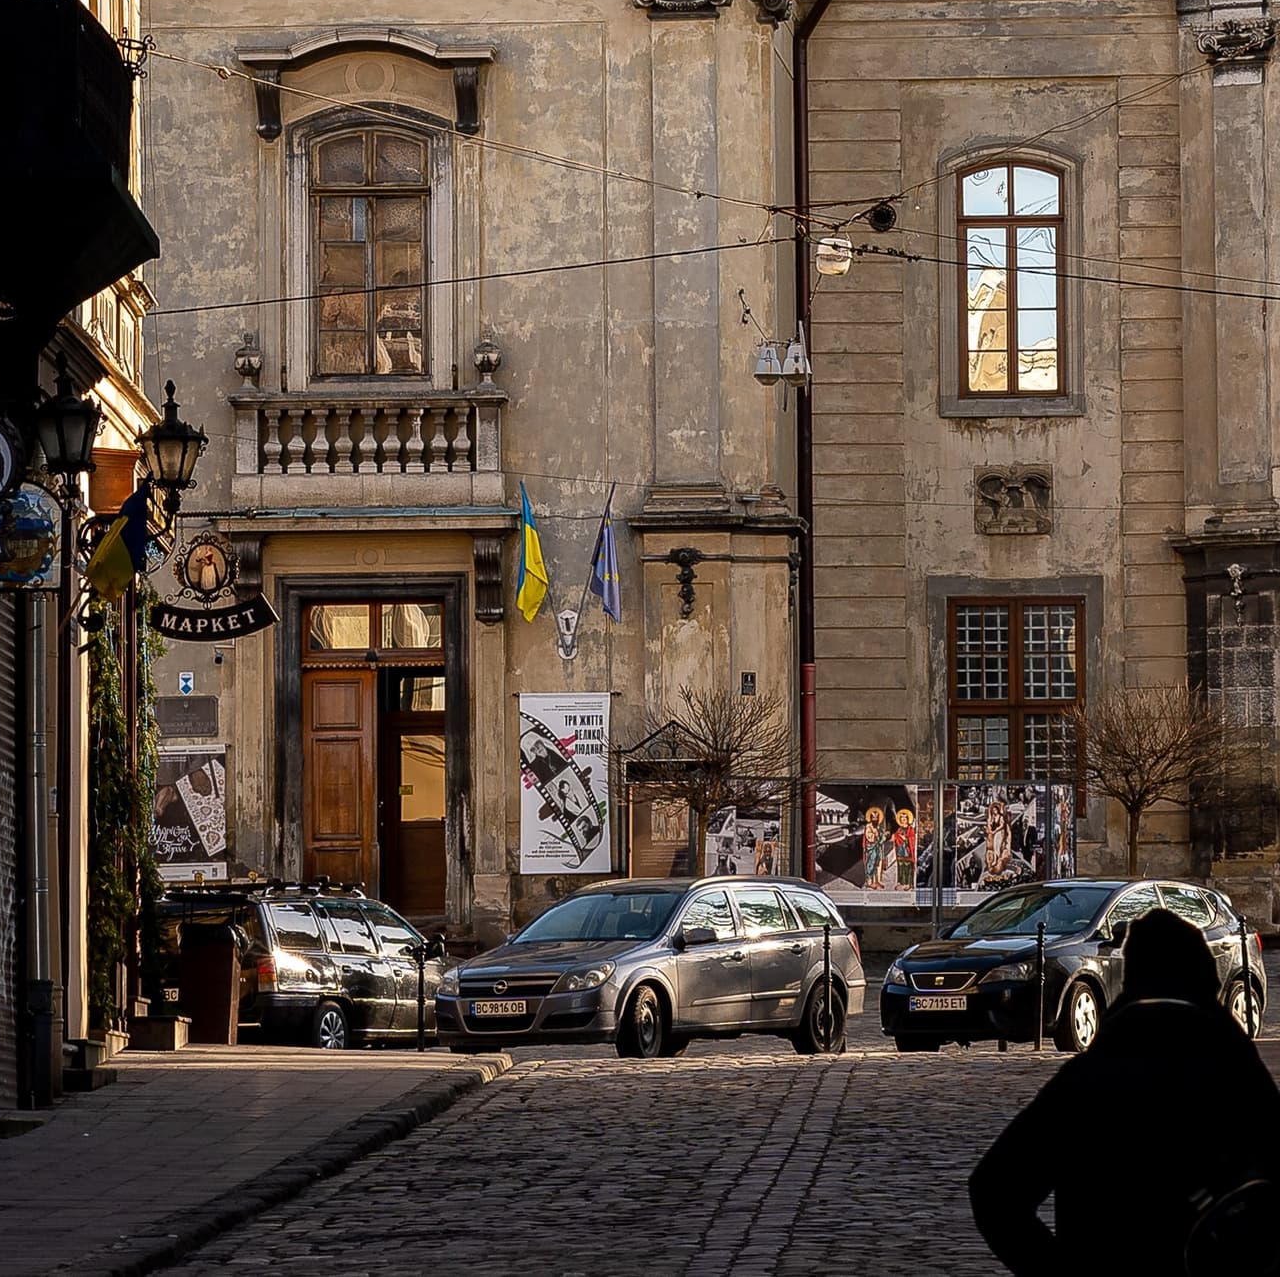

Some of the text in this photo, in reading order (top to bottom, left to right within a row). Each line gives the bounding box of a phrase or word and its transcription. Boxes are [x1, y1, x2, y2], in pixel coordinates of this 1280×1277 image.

[160, 608, 256, 633] МАРКЕТ
[564, 714, 604, 727] ТРИ ЖИТТЯ
[574, 726, 604, 741] ВЕЛИКОЇ
[574, 743, 604, 756] ЛЮДИНИ
